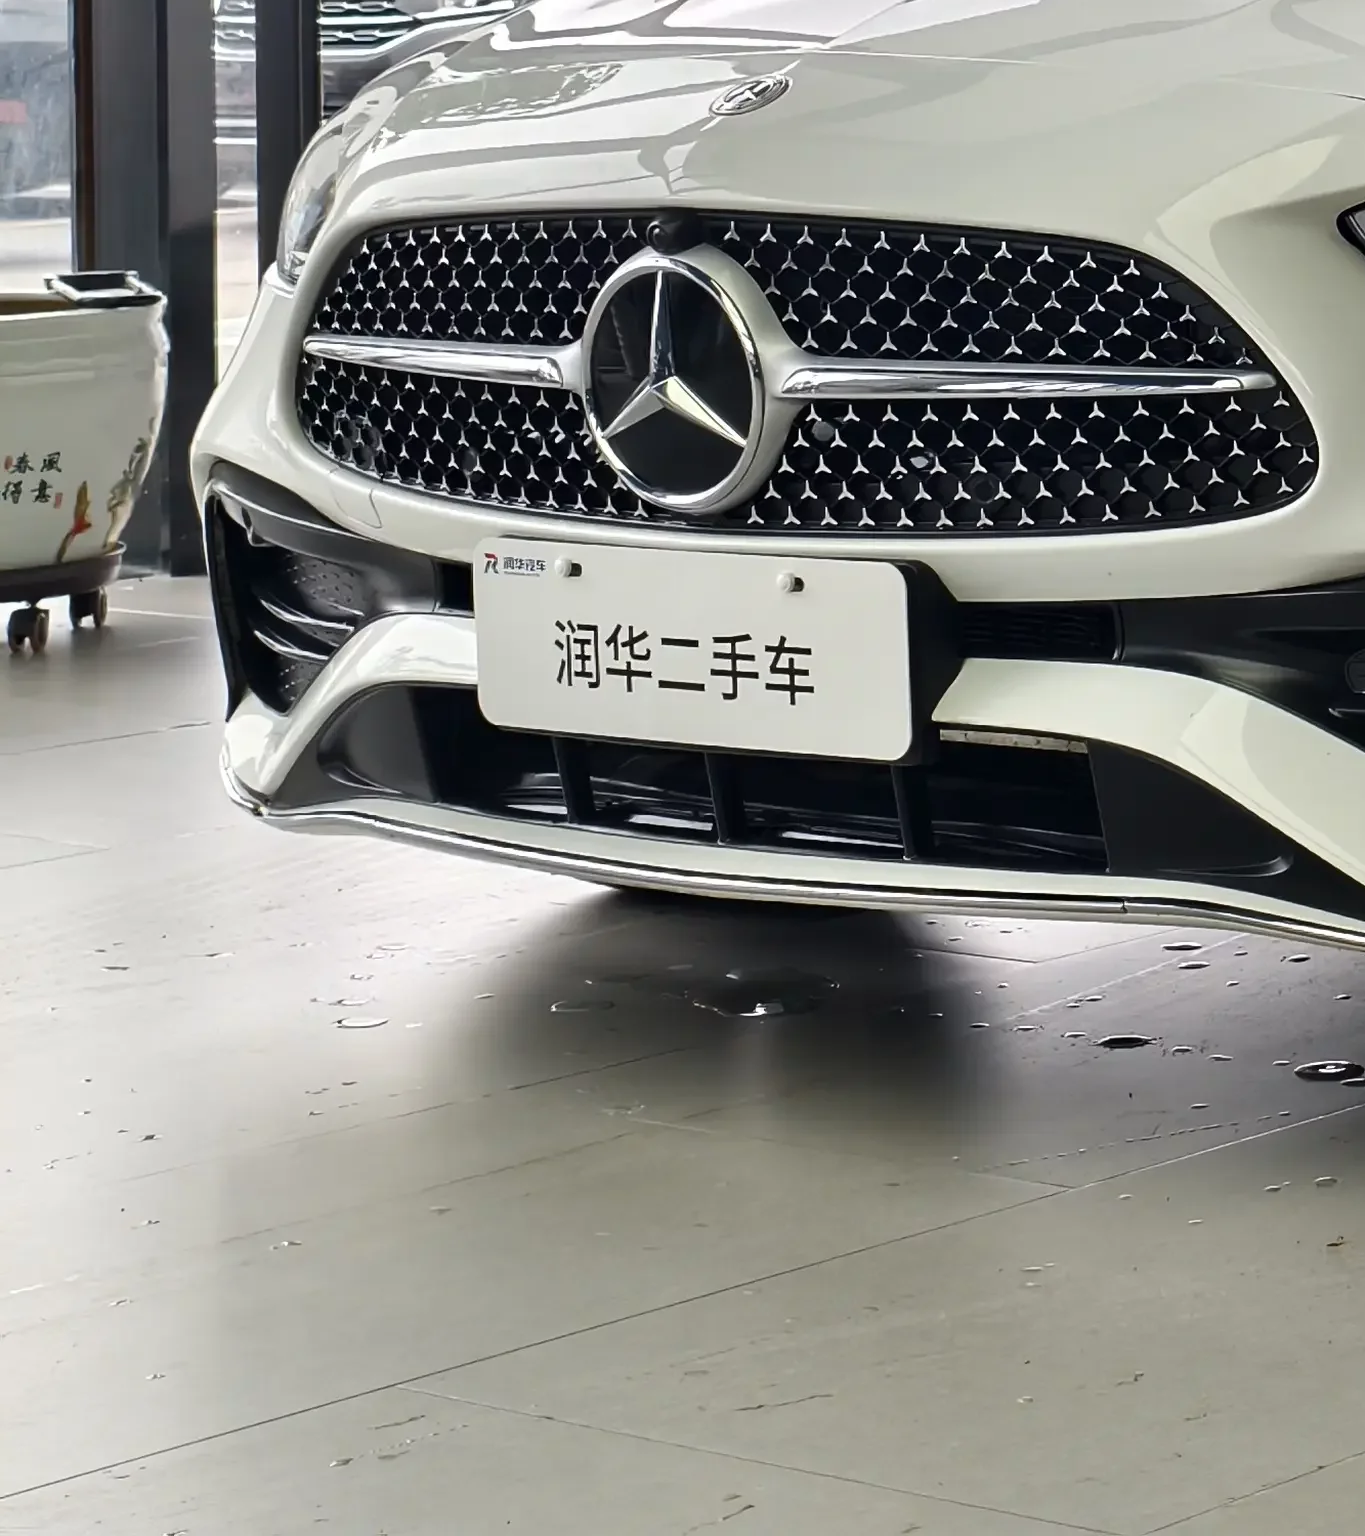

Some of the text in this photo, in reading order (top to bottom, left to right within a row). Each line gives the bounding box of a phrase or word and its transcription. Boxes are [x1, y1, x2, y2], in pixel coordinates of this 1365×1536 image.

[554, 619, 815, 706] 润华二手车
